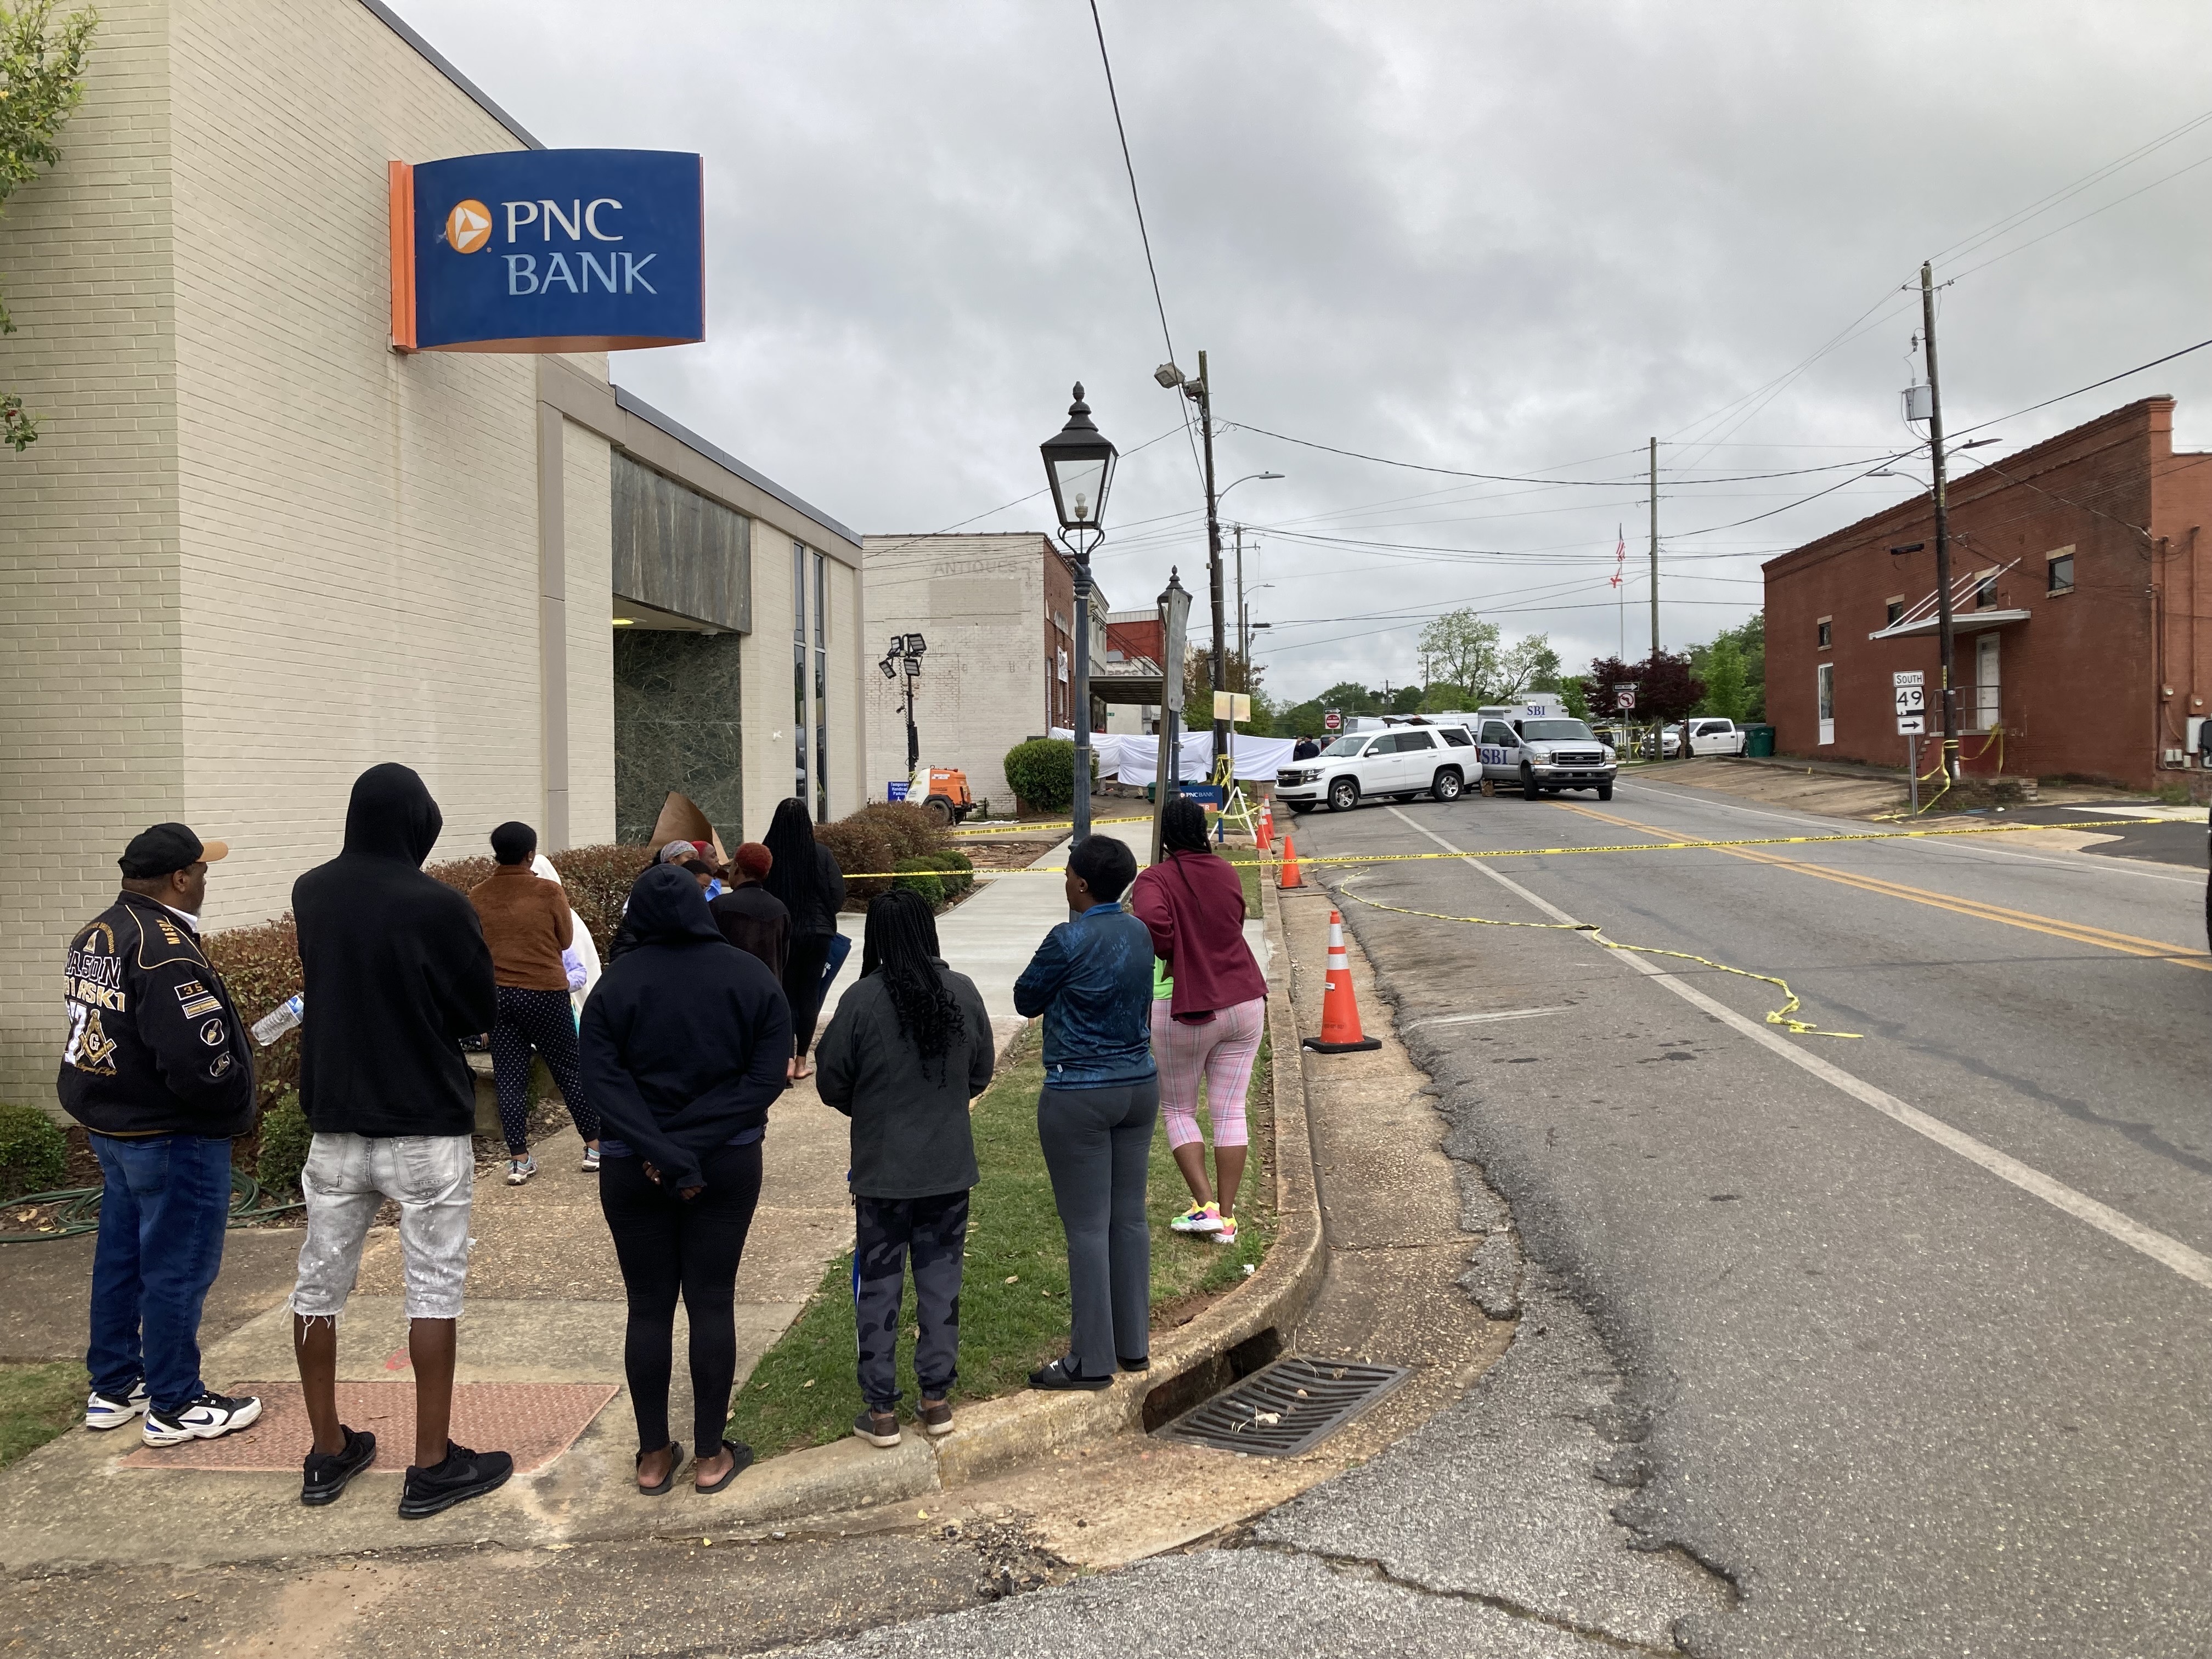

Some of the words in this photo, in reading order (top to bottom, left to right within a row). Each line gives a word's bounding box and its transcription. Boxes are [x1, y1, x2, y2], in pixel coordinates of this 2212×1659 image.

[501, 198, 624, 243] PNC
[501, 251, 658, 296] BANK
[934, 560, 1018, 574] ANTIQUES
[1897, 674, 1922, 684] SOUTH
[1897, 690, 1922, 707] 49
[1527, 706, 1545, 715] SBI
[1482, 749, 1508, 765] SBI
[89, 1032, 100, 1051] G
